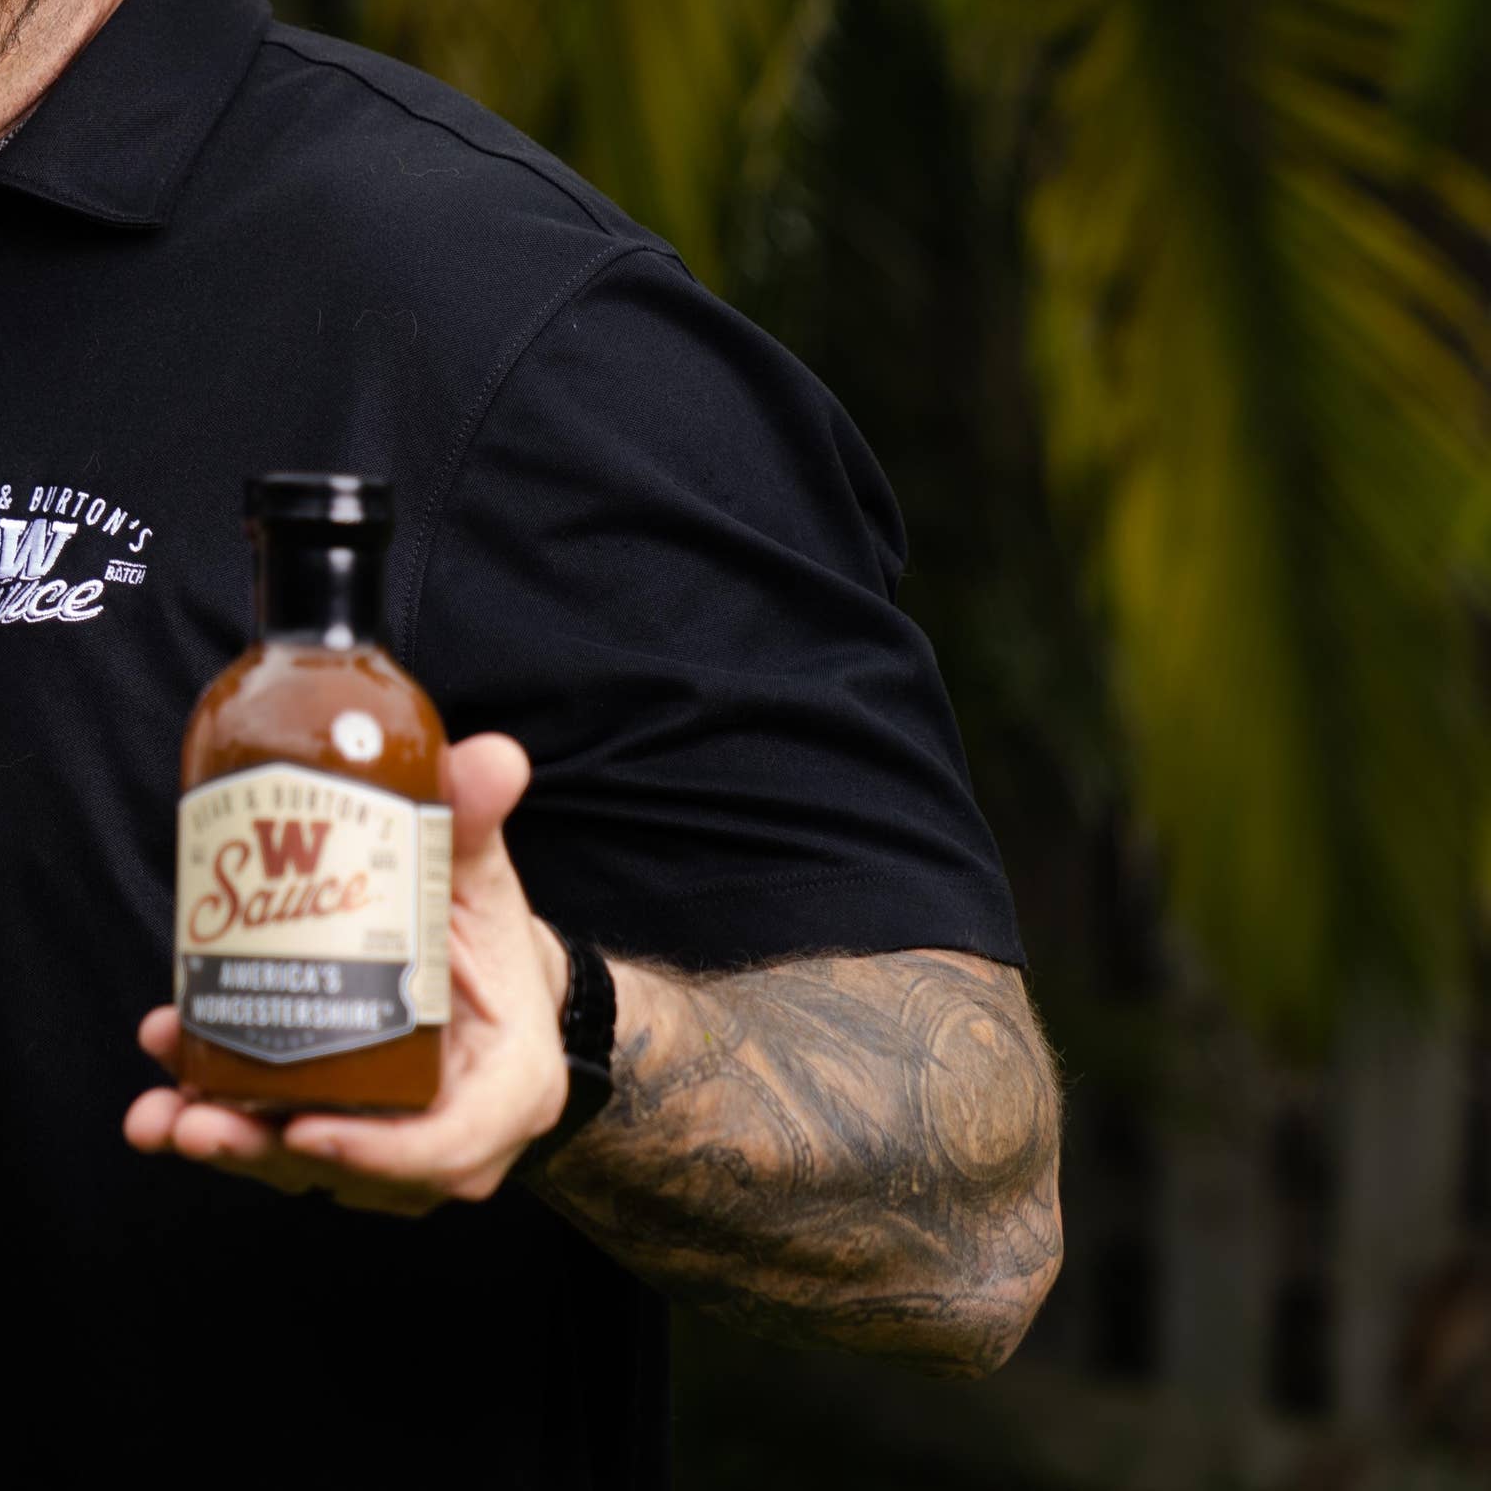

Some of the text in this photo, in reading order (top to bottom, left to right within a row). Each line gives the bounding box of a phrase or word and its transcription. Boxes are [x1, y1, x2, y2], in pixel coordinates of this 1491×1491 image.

[29, 485, 153, 553] BURTON'S
[104, 565, 147, 586] BATCH
[252, 818, 333, 879] W
[187, 838, 369, 945] Sauce
